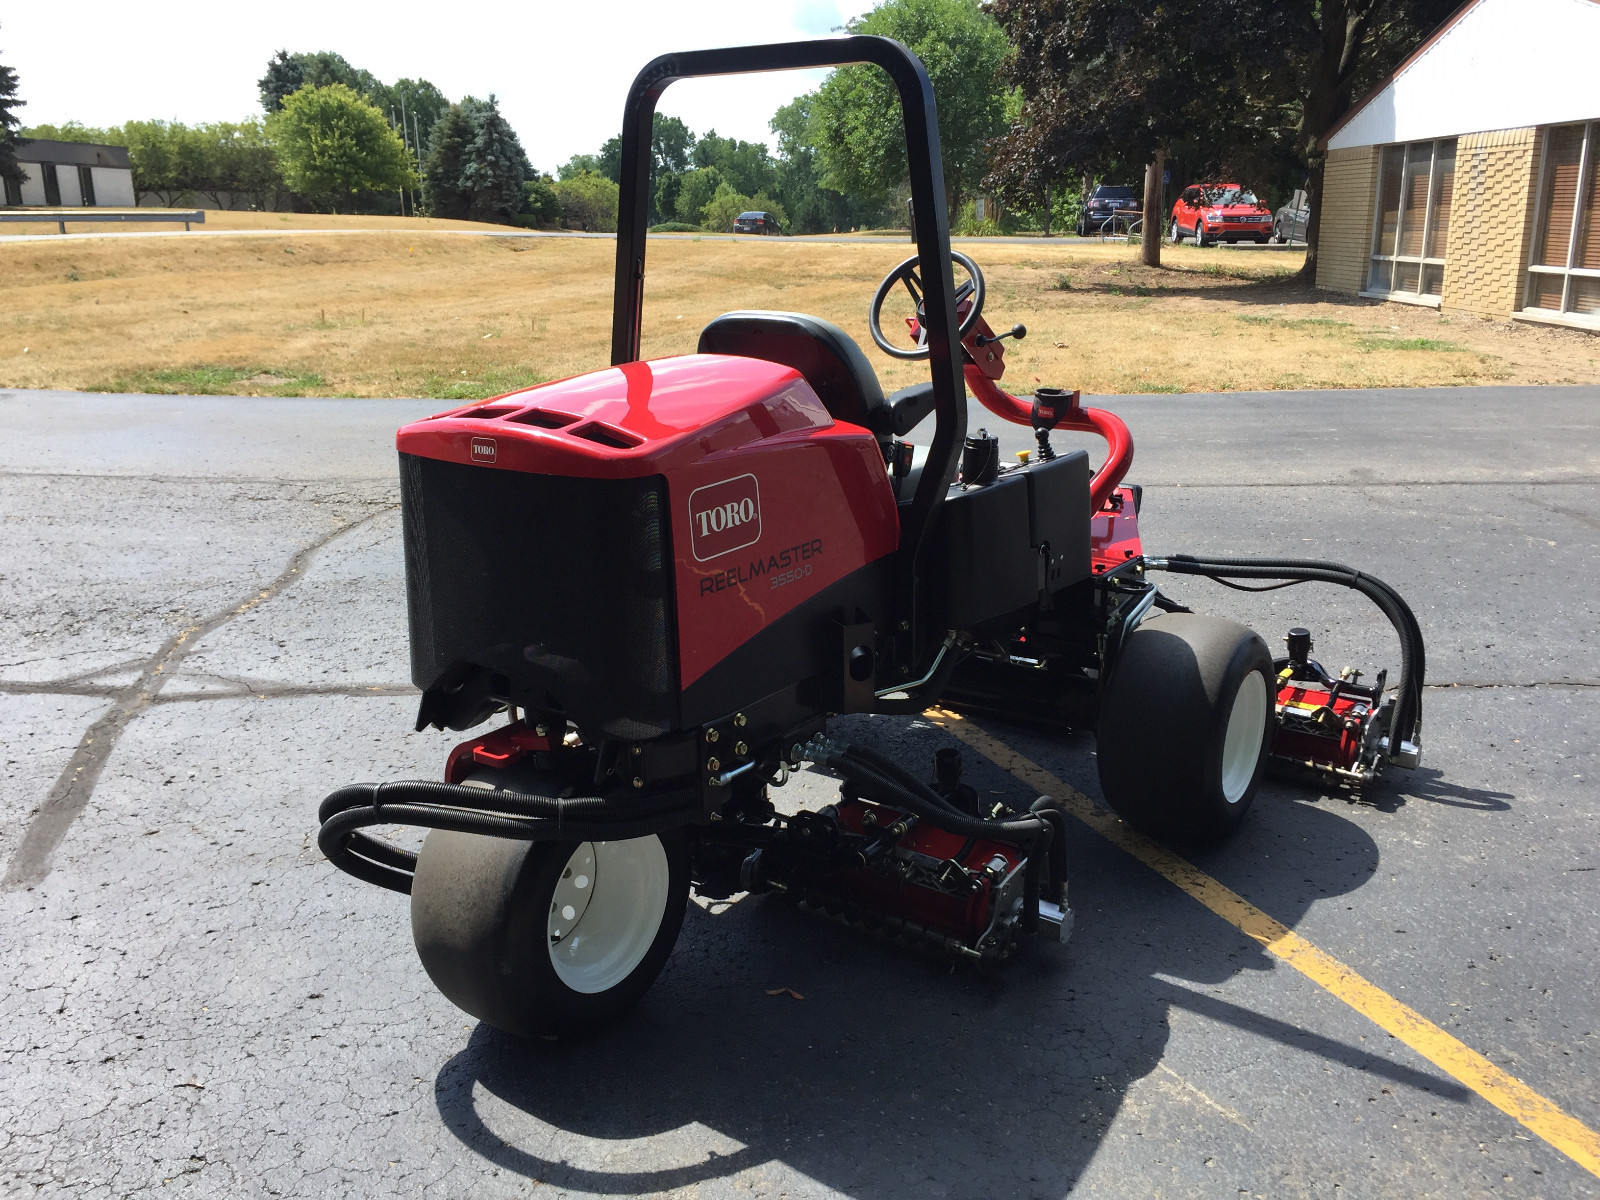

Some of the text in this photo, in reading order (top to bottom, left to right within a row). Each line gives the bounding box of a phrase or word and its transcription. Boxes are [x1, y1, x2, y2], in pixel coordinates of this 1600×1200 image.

[473, 444, 495, 456] TORO
[696, 497, 755, 538] TORO
[700, 538, 823, 597] REELMASTER
